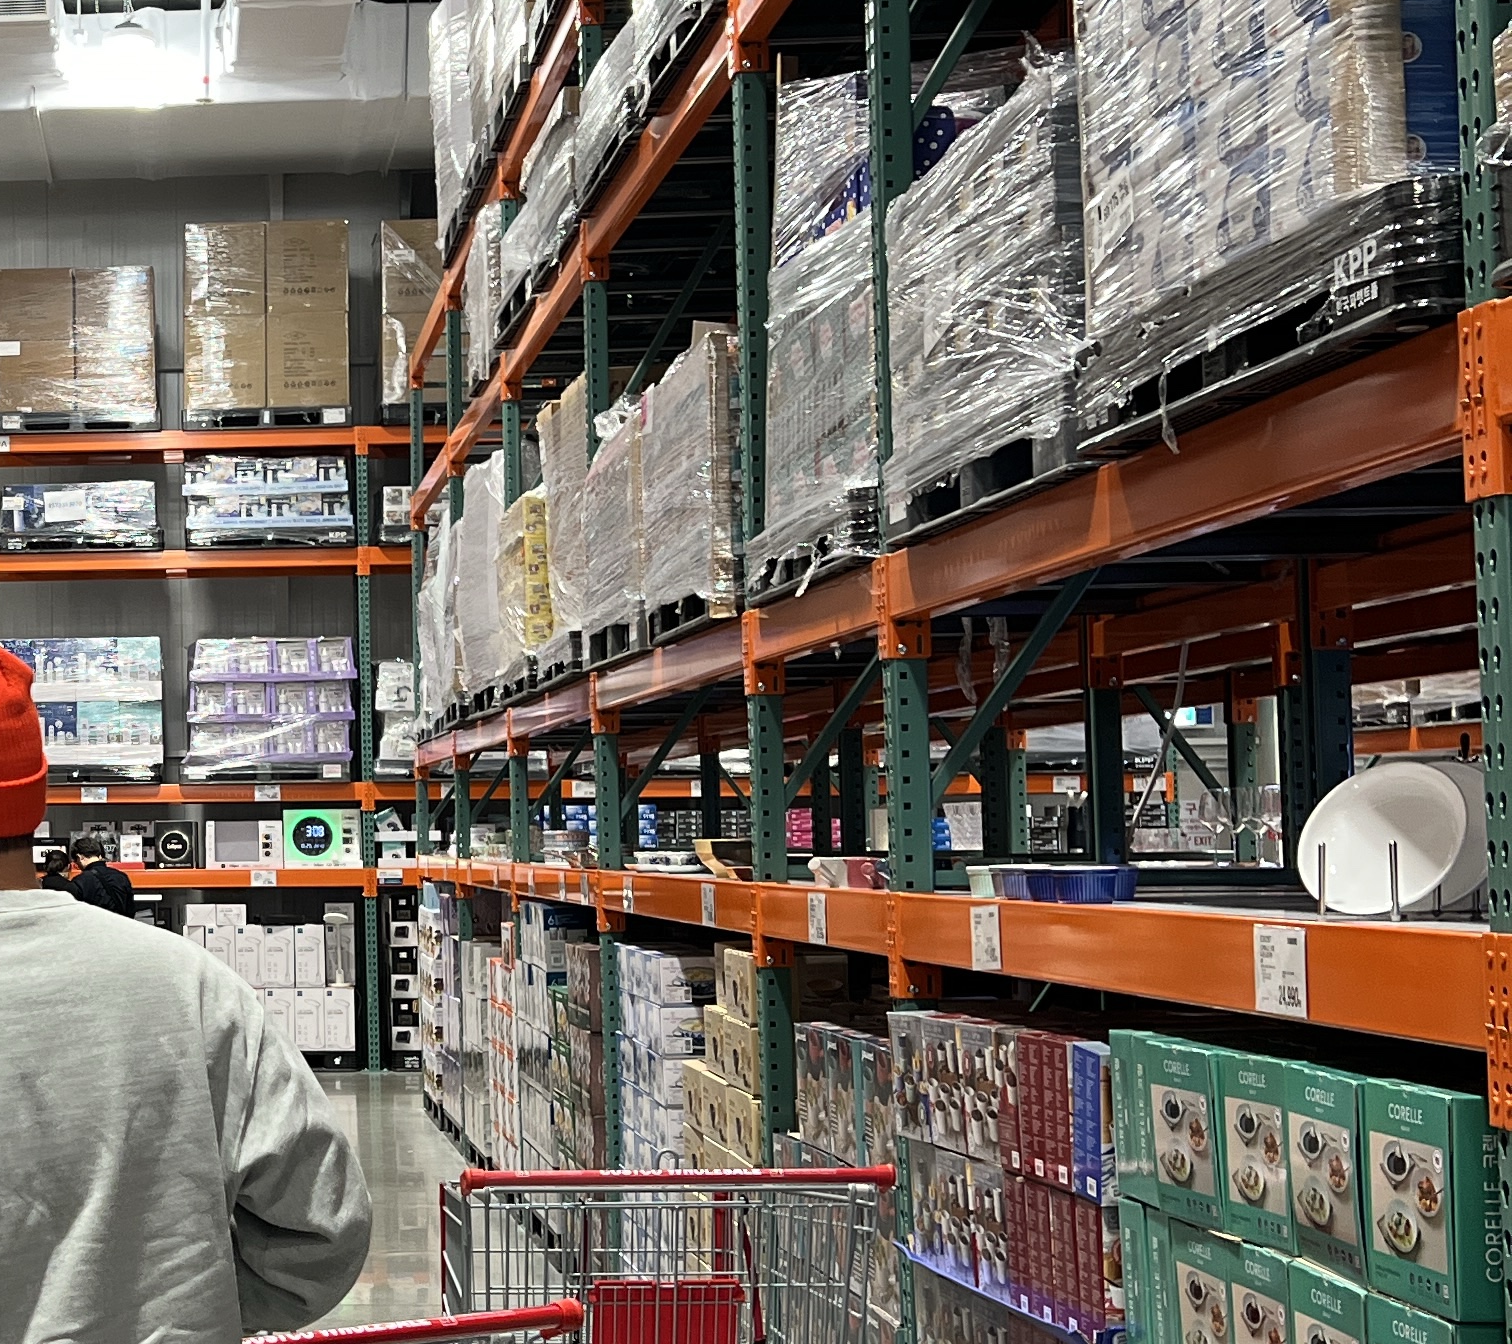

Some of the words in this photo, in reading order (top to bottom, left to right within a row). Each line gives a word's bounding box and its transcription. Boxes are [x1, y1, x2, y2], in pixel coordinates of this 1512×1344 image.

[1333, 238, 1378, 287] KPP
[1193, 835, 1212, 847] EXIT
[1304, 1086, 1336, 1107] CORELLE
[1387, 1103, 1424, 1126] CORELLE
[1483, 1180, 1505, 1284] CORELLE
[1311, 1288, 1343, 1315] CORELLE
